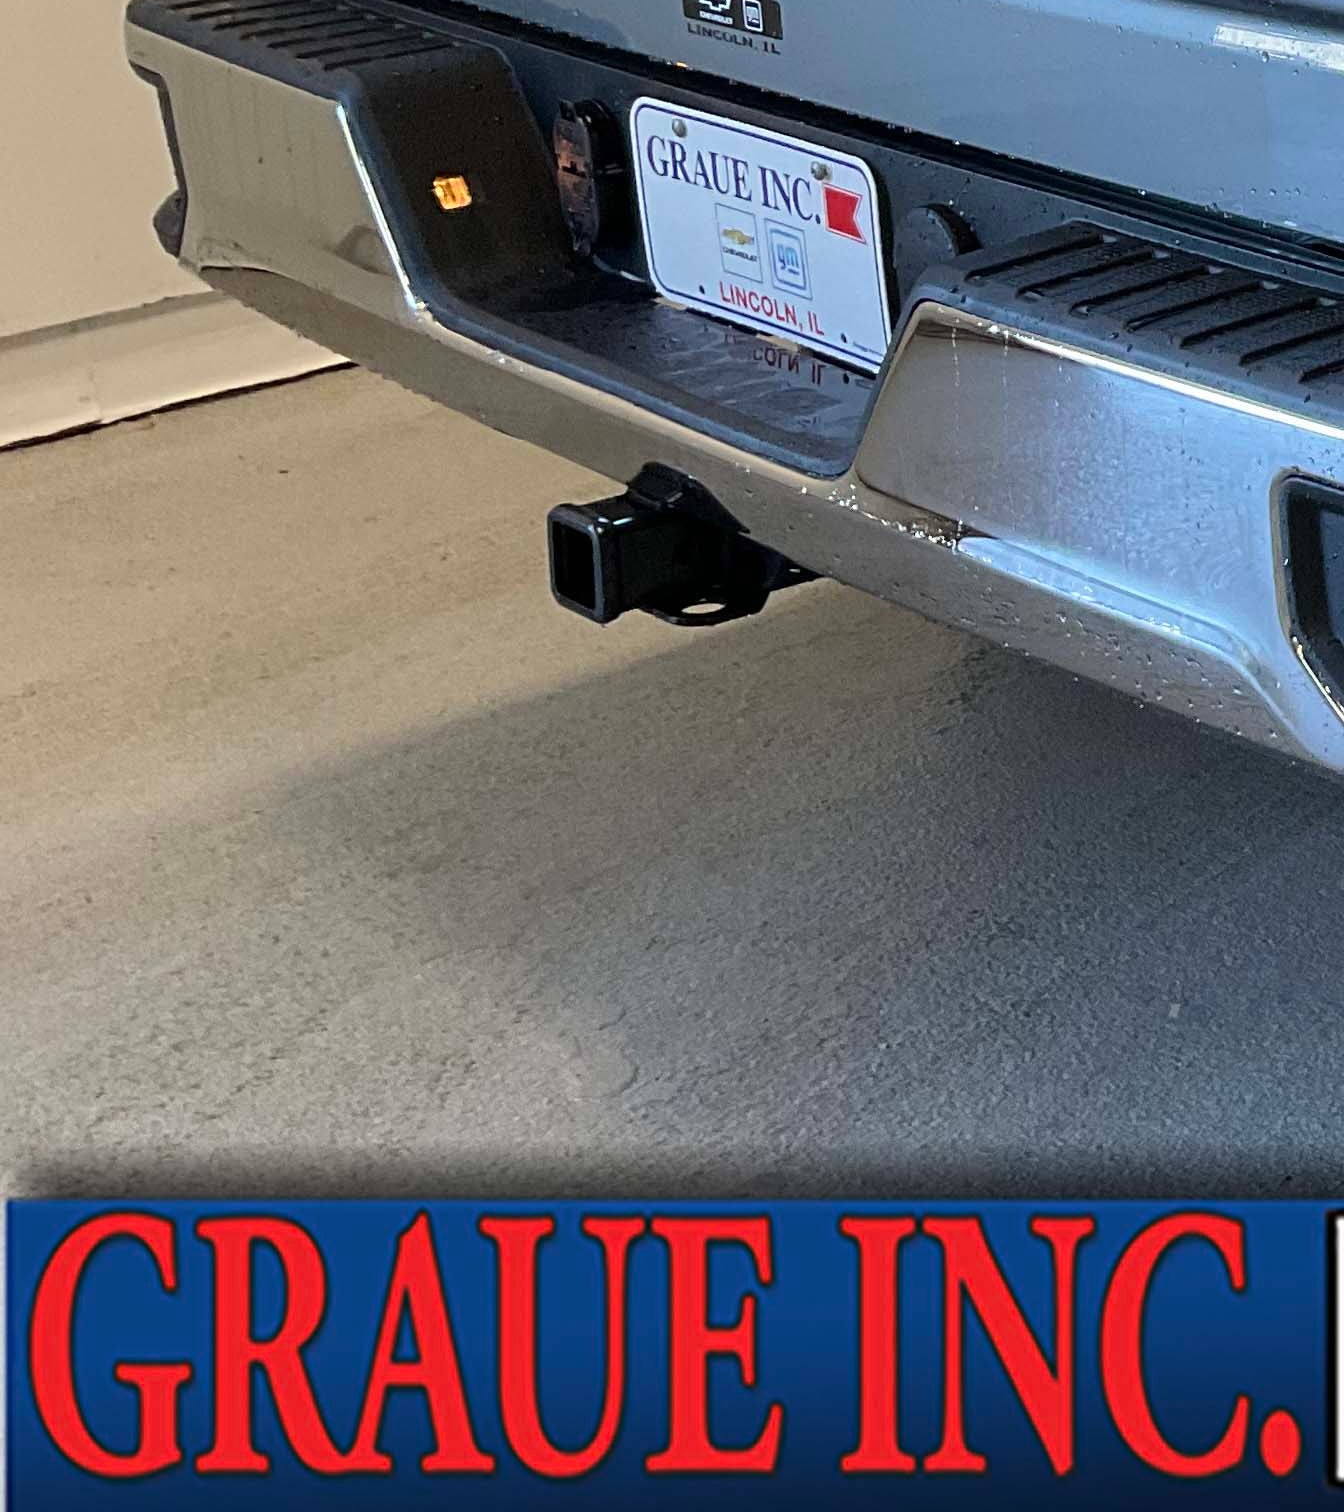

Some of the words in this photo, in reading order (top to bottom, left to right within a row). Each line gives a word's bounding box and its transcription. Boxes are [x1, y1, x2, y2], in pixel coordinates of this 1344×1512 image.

[762, 40, 782, 56] IL
[646, 134, 753, 202] GRAUE
[758, 165, 821, 224] INC.
[719, 280, 804, 332] LINCOLN,
[807, 310, 825, 336] IL
